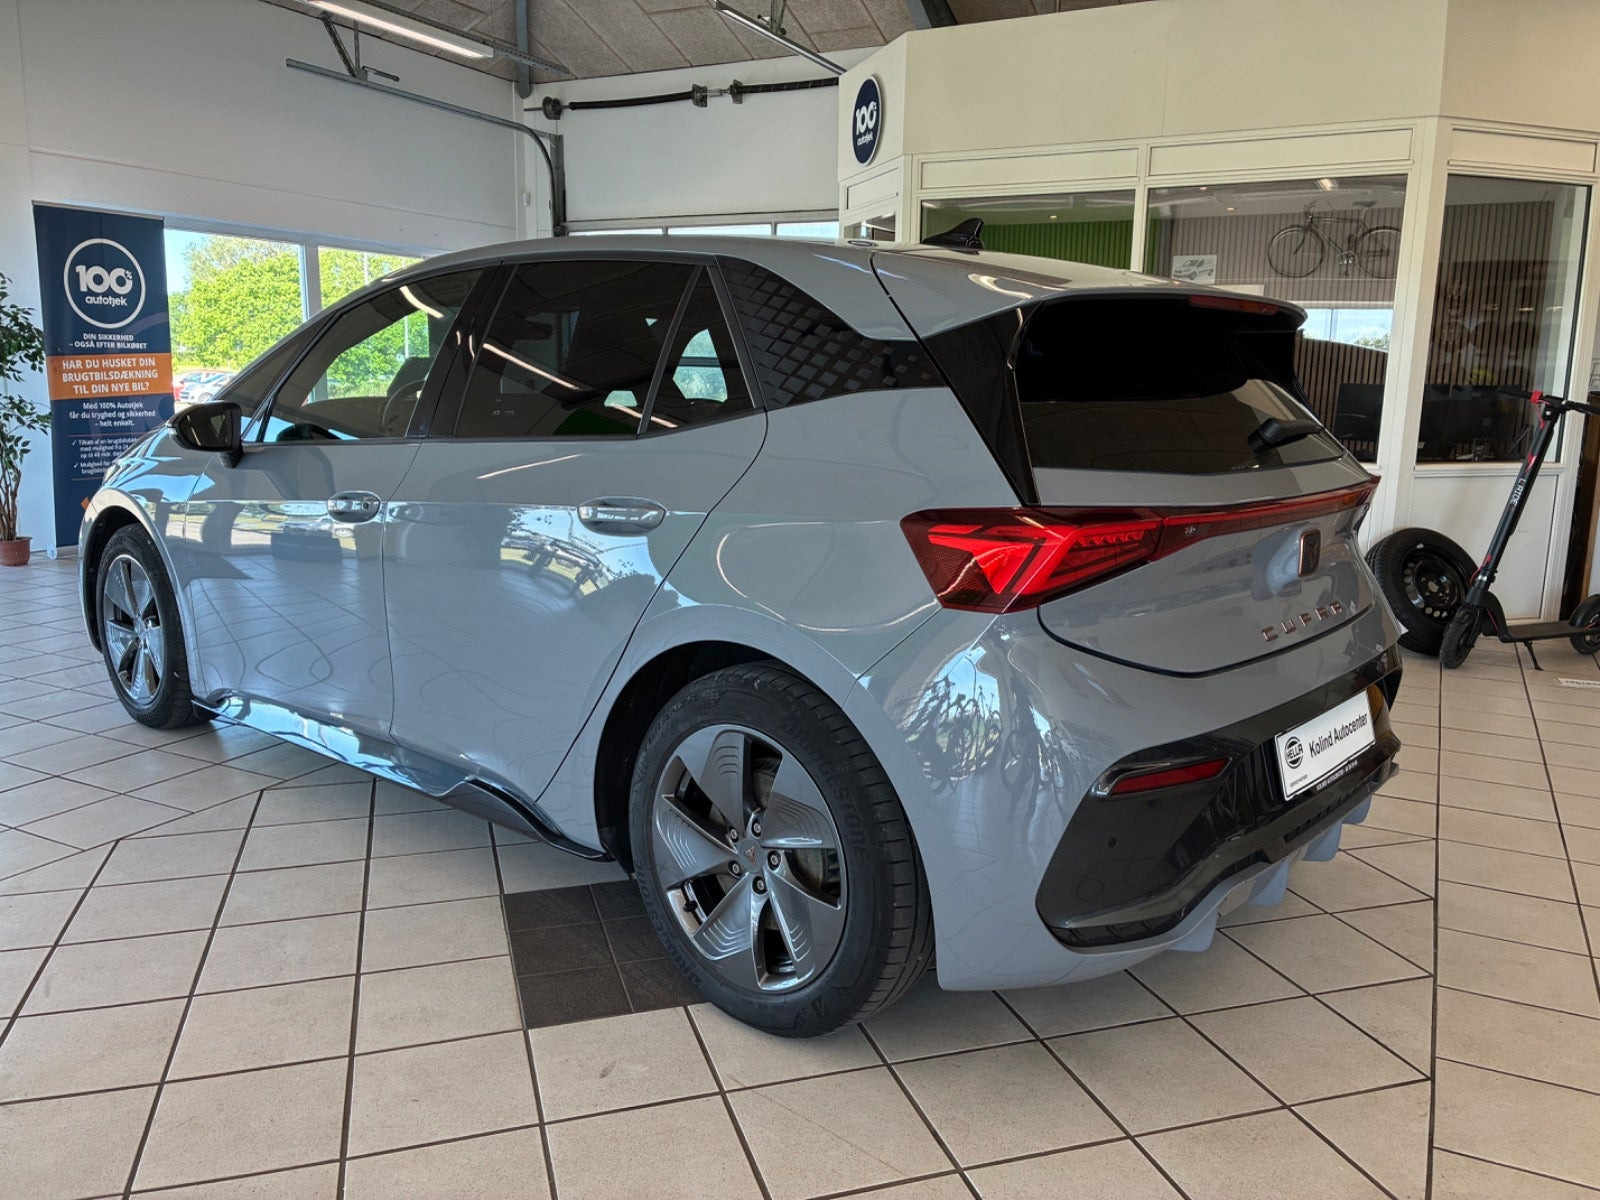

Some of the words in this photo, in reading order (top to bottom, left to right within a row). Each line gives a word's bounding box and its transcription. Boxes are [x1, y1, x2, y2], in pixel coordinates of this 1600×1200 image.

[85, 295, 127, 307] autotjek
[98, 333, 134, 341] SIKKERHED
[74, 340, 95, 348] OGSÅ
[62, 360, 83, 370] HAR
[85, 359, 99, 369] DU
[102, 358, 137, 368] HUSKET
[139, 357, 156, 367] DIN
[62, 369, 158, 383] BRUGTBILSDÆKNING
[73, 384, 89, 394] TIL
[91, 383, 109, 393] DIN
[111, 382, 130, 392] NYE
[131, 381, 150, 391] BIL?
[82, 402, 98, 410] Med
[117, 401, 144, 410] Autotjek
[69, 411, 79, 419] får
[81, 411, 90, 419] du
[91, 410, 116, 420] tryghed
[1308, 731, 1334, 759] Kolind
[1333, 711, 1369, 744] Autocenter
[1285, 742, 1304, 760] HELLA
